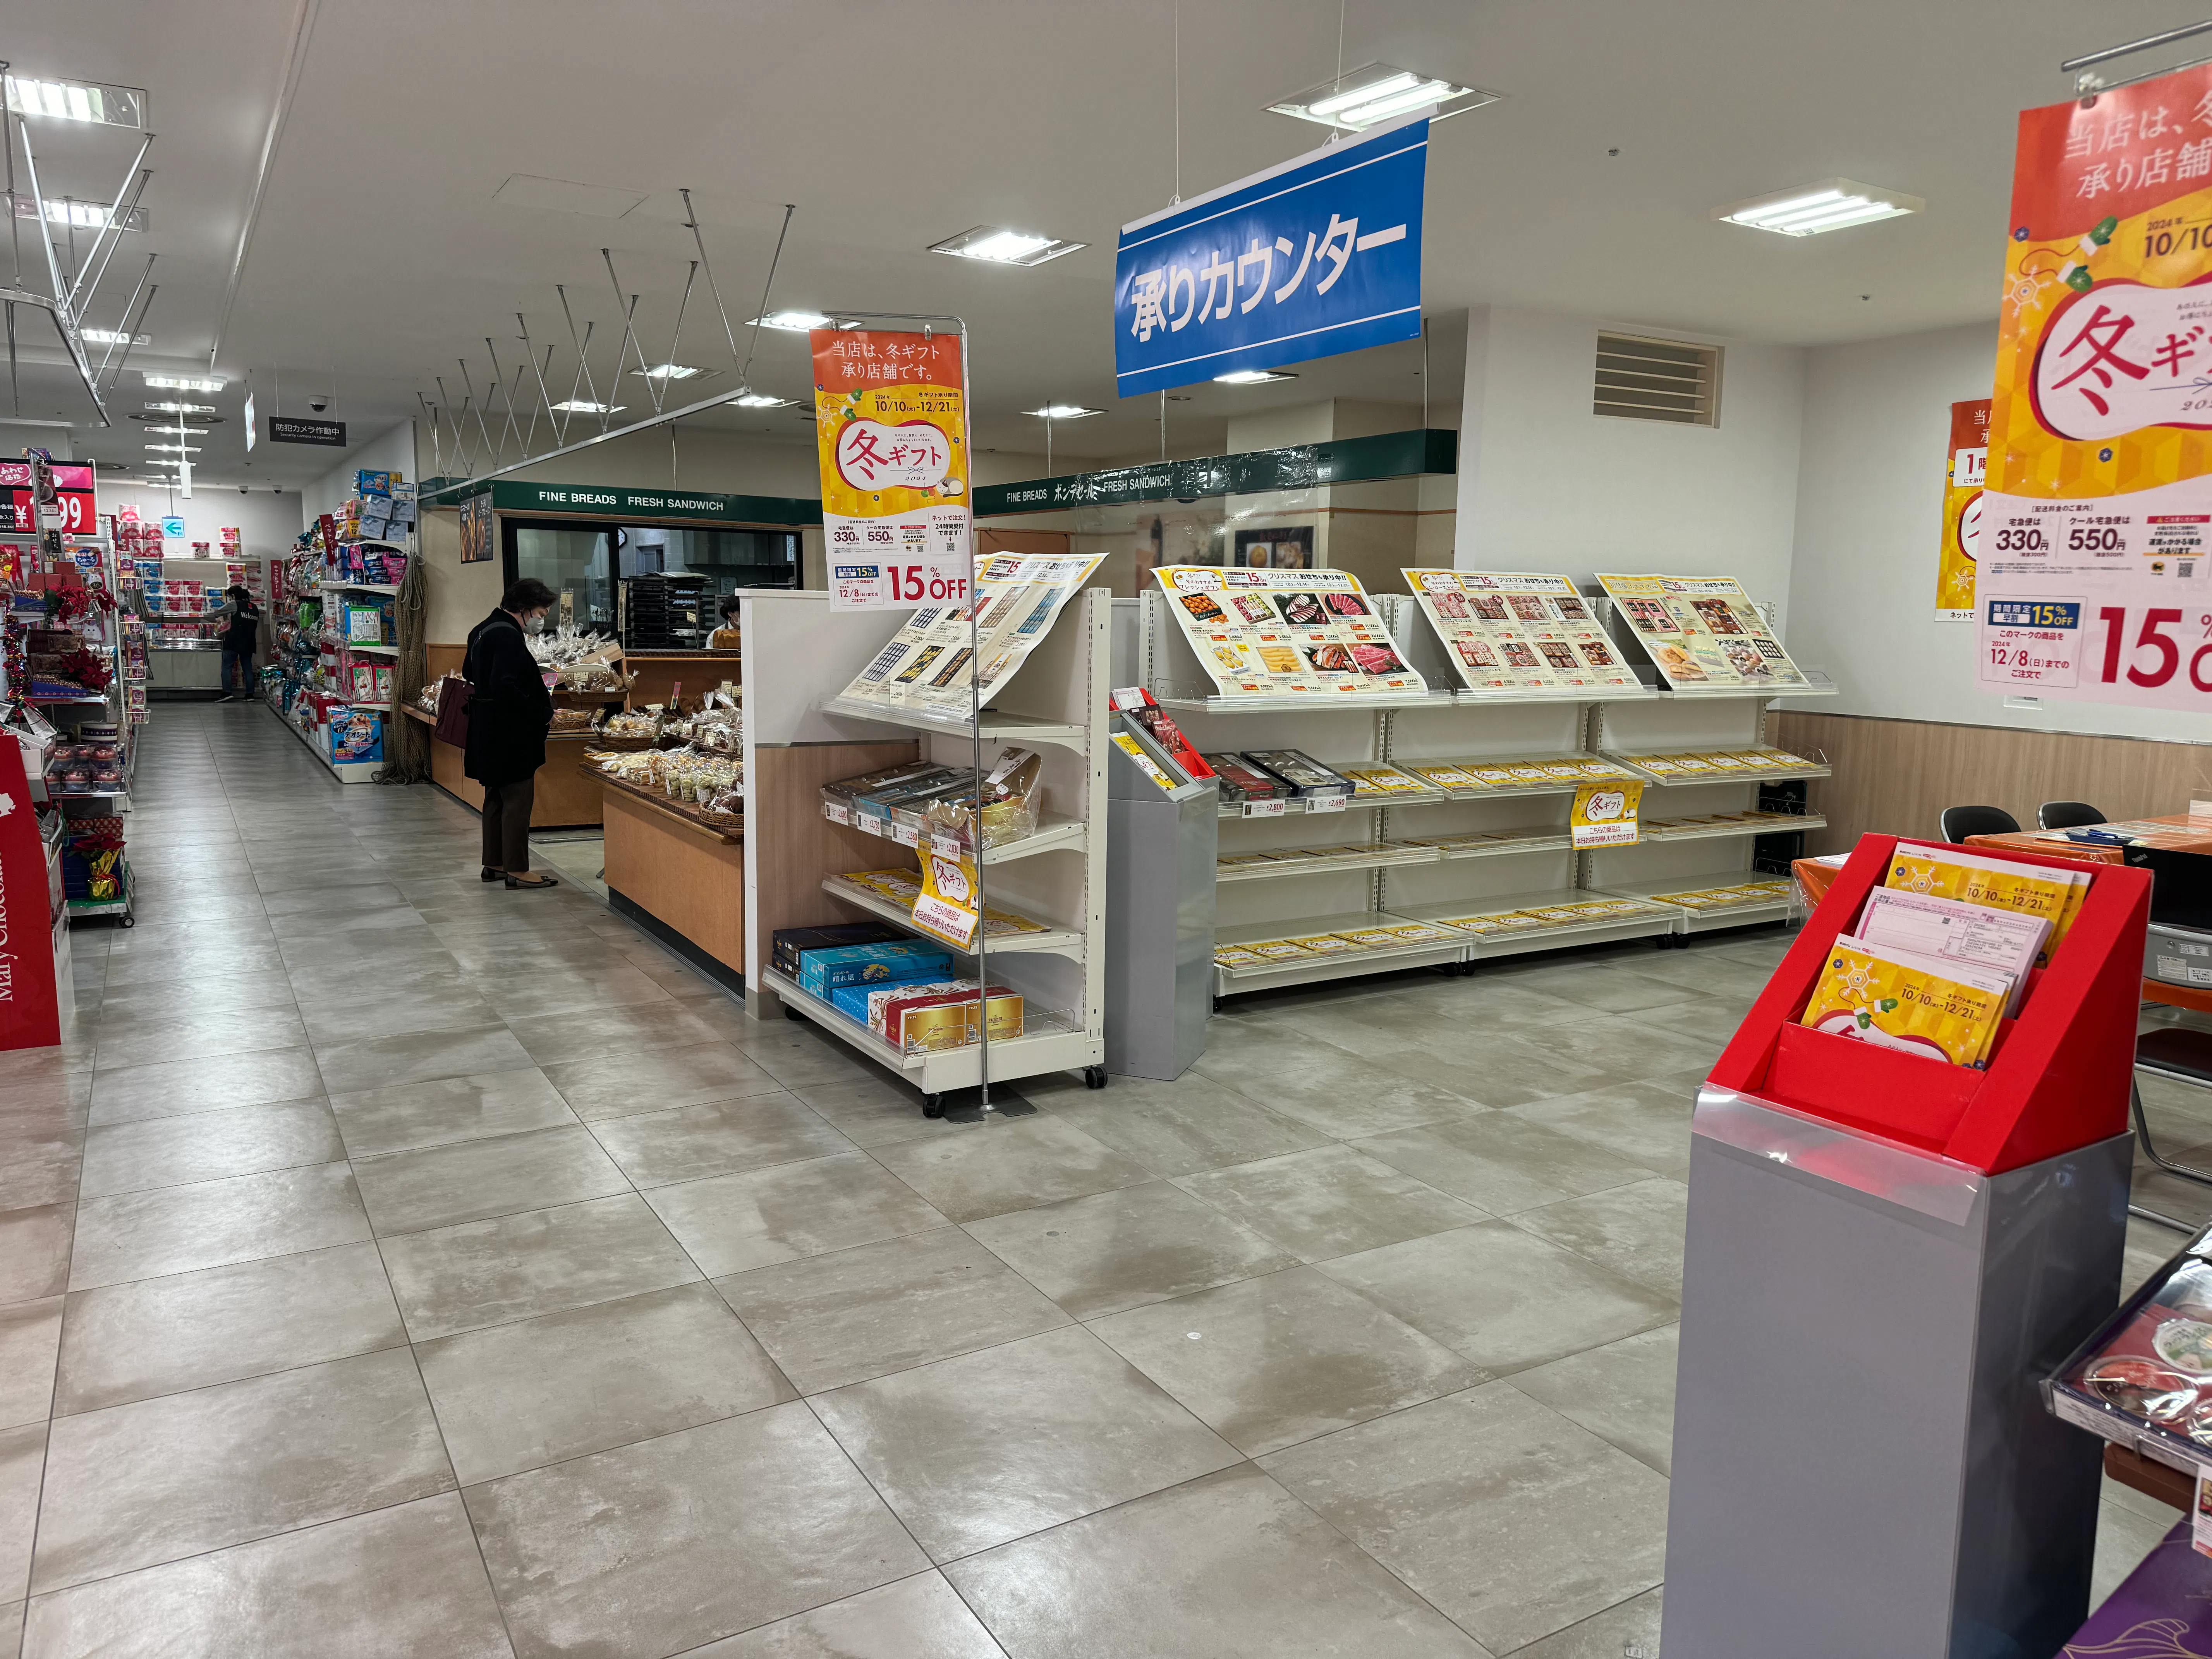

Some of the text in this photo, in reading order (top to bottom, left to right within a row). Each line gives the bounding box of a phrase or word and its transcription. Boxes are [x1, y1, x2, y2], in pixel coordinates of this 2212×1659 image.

[1131, 214, 1407, 342] 承りカウンター
[831, 340, 939, 360] 当店は、冬ギフト
[2051, 305, 2212, 416] 冬ギ
[841, 362, 932, 380] 承り店舗です。
[276, 424, 339, 435] 防犯カメラ作動中
[846, 428, 942, 481] 冬ギフト
[1104, 475, 1170, 493] FRESH SANDWICH
[539, 491, 724, 511] FINE BREADS FRESH SANDWICH
[1007, 489, 1047, 503] FINE BREADS
[2069, 517, 2130, 525] クール宅急便は
[325, 524, 335, 555] ペットシート
[929, 579, 967, 599] OFF
[2054, 617, 2073, 626] OFF
[2000, 630, 2064, 640] このマークの商品を
[2011, 670, 2041, 679] ご注文で
[1589, 795, 1620, 816] 冬ギフト
[1576, 833, 1635, 844] 本日お持ち帰りいただけます
[1589, 826, 1620, 834] こちらの商品は
[930, 903, 960, 922] こちらの商品は
[914, 909, 968, 940] 本日お持ち帰りいただけます
[833, 974, 855, 982] 晴れ風
